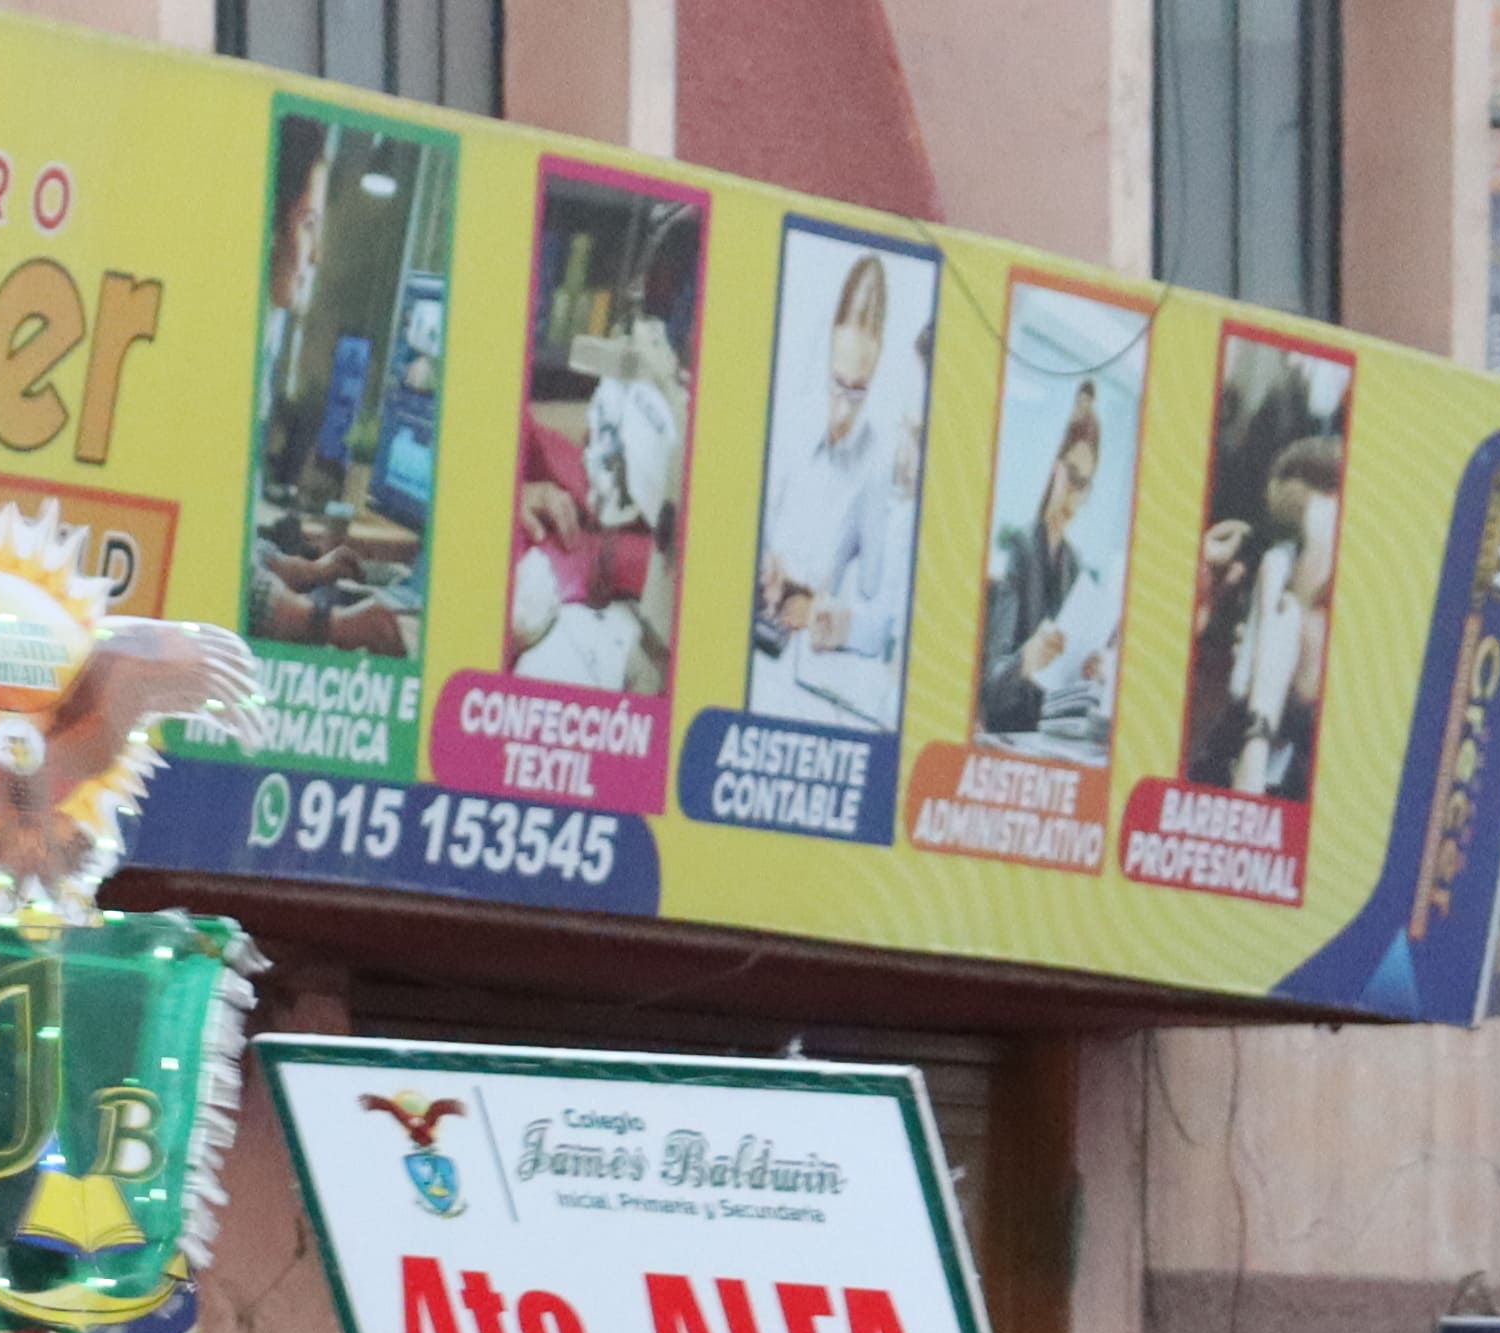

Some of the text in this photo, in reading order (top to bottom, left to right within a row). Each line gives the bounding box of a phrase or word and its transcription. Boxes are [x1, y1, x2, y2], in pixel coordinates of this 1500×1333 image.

[396, 677, 422, 721] E
[459, 688, 652, 758] CONFECCIÓN
[503, 744, 595, 800] TEXTIL
[715, 723, 869, 790] ASISTENTE
[956, 753, 1080, 817] ASISTENTE
[296, 779, 617, 883] 915 153545
[711, 773, 861, 836] CONTABLE
[912, 797, 1105, 867] ADMINISTRATIVO
[1159, 788, 1284, 850] BARBERIA
[1125, 830, 1300, 900] PROFESIONAL
[94, 1086, 167, 1184] B
[562, 1108, 648, 1135] Colegio
[515, 1117, 849, 1197] James Baldwin
[617, 1193, 698, 1219] Primaria
[719, 1198, 827, 1225] Secundaria
